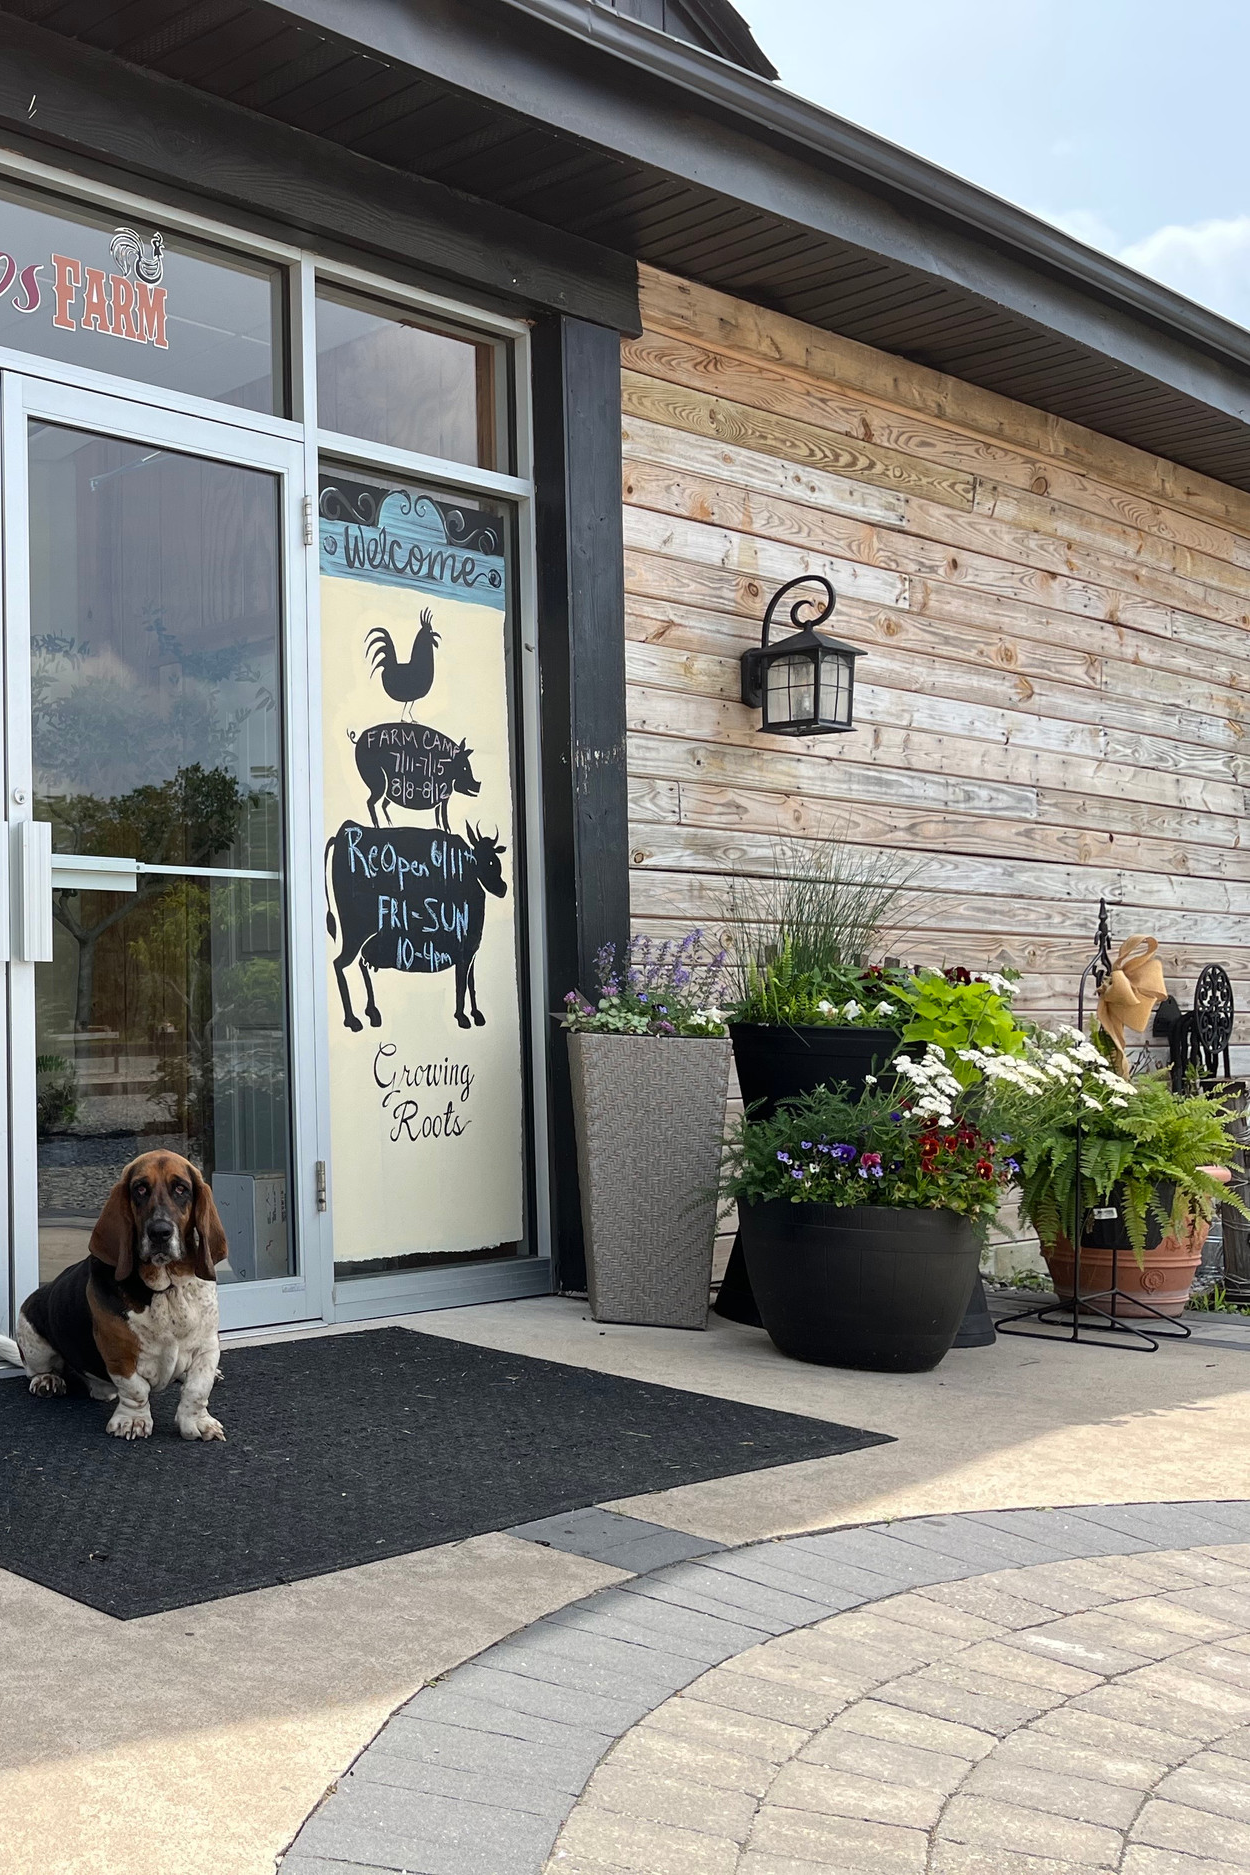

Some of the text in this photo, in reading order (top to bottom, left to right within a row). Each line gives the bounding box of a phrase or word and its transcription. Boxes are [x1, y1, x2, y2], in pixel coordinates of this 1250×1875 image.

[51, 253, 169, 349] FARM
[344, 524, 477, 588] Welcome
[367, 728, 461, 759] FARM CAMP
[390, 750, 452, 777] 7/11-7/15
[391, 775, 450, 805] 8/8-8/12
[373, 1041, 475, 1108] Growing
[390, 1100, 472, 1142] Roots
